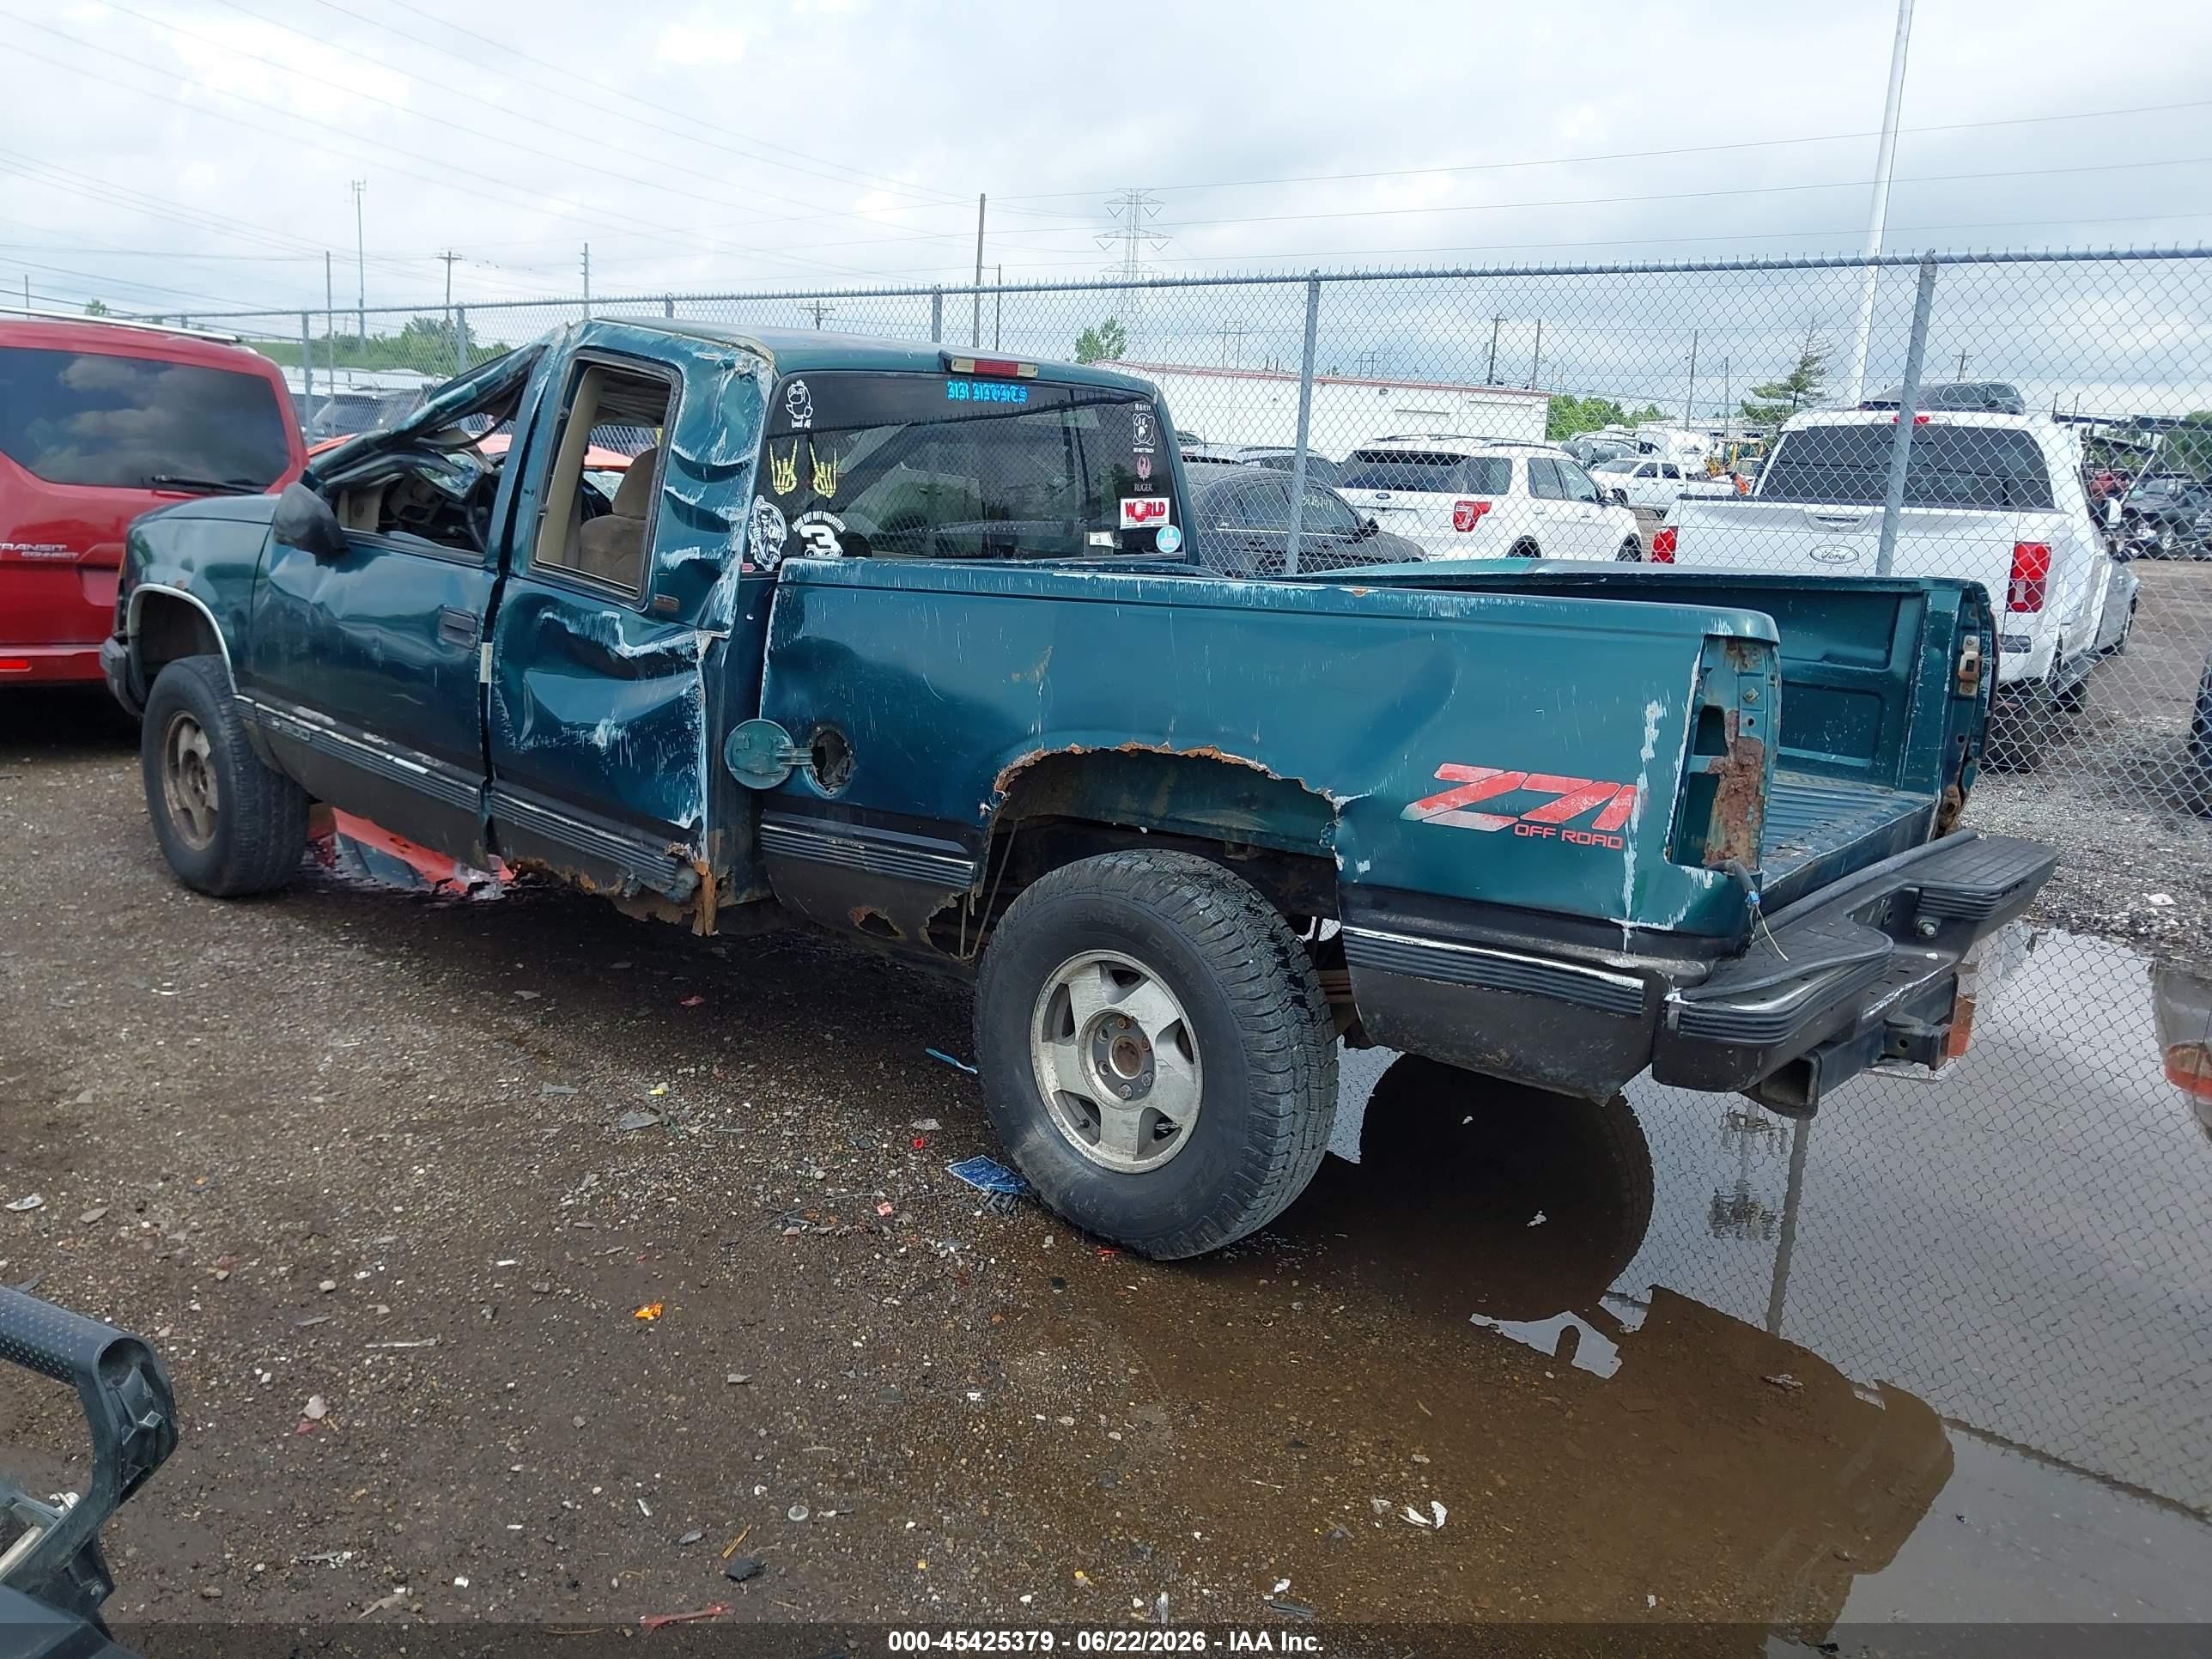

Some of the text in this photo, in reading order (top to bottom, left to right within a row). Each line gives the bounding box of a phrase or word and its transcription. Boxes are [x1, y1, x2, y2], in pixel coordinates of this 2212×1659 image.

[1134, 483, 1153, 492] RUGER
[0, 543, 67, 551] RANSIT
[800, 525, 840, 552] 3
[1399, 763, 1638, 832] Z71
[1513, 823, 1623, 849] OFF ROAD
